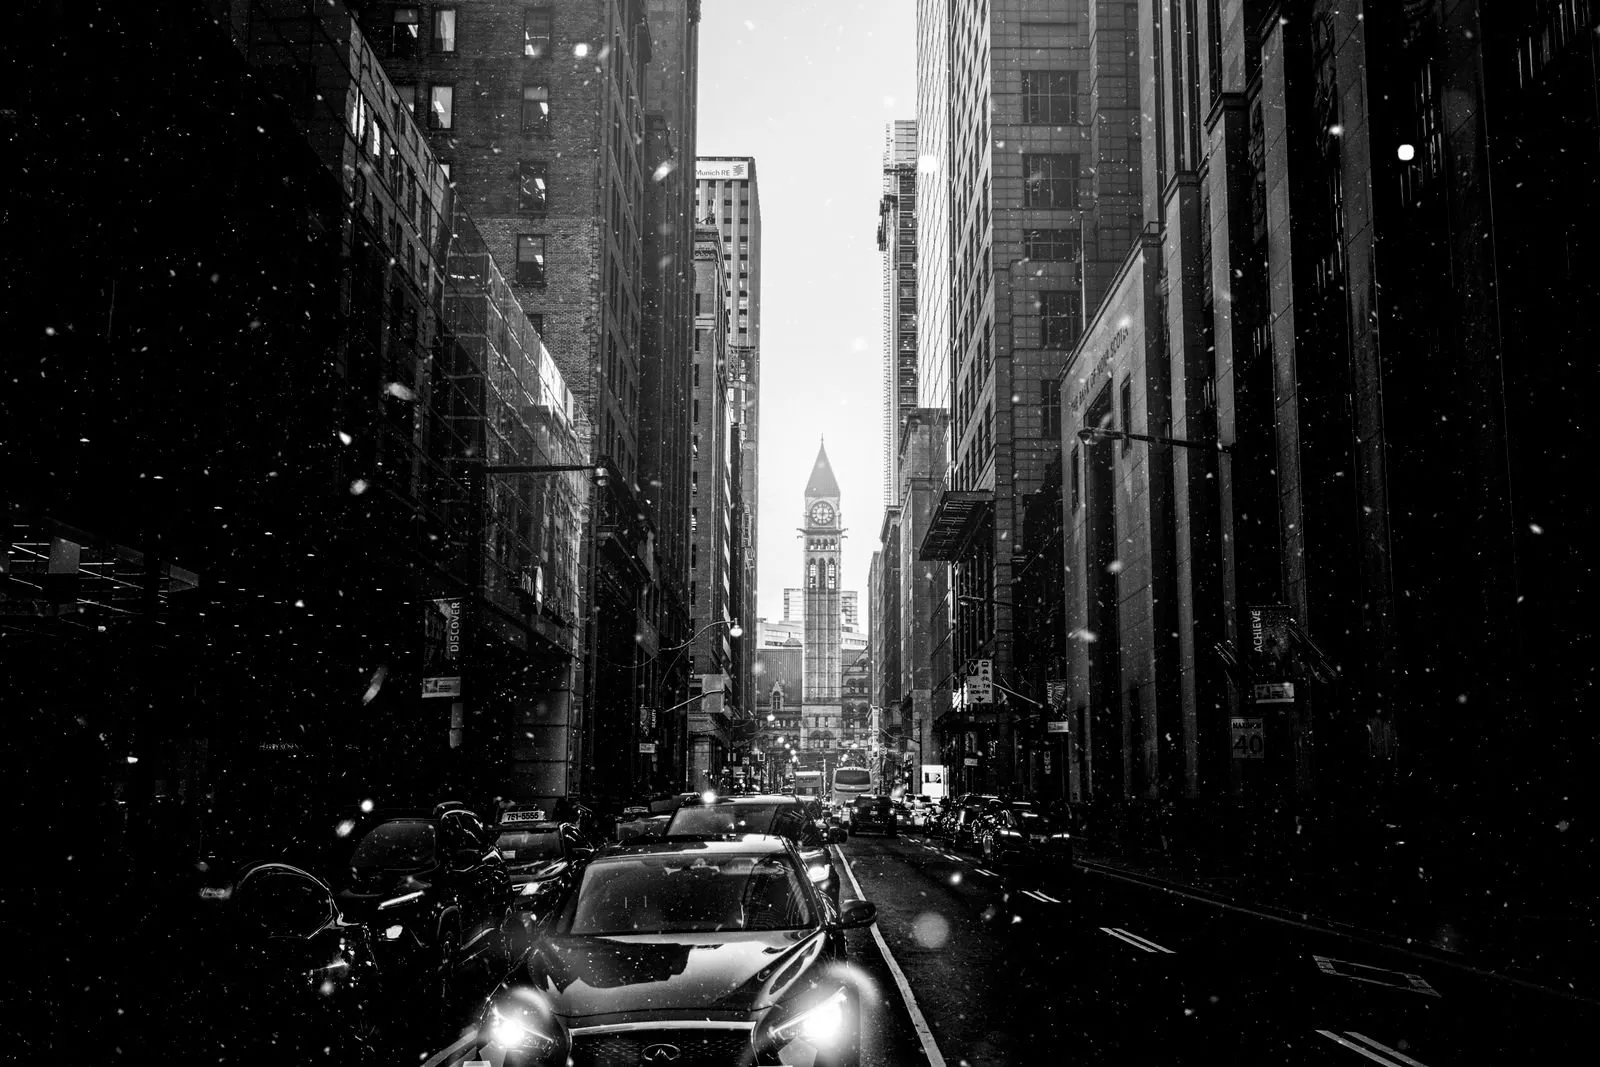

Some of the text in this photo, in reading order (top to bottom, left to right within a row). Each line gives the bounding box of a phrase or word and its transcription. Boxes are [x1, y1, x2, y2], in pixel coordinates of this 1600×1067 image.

[449, 601, 461, 653] DISCOVER
[1252, 609, 1263, 653] ACHIEVE
[1234, 735, 1263, 755] 40
[506, 812, 539, 820] 751-5555
